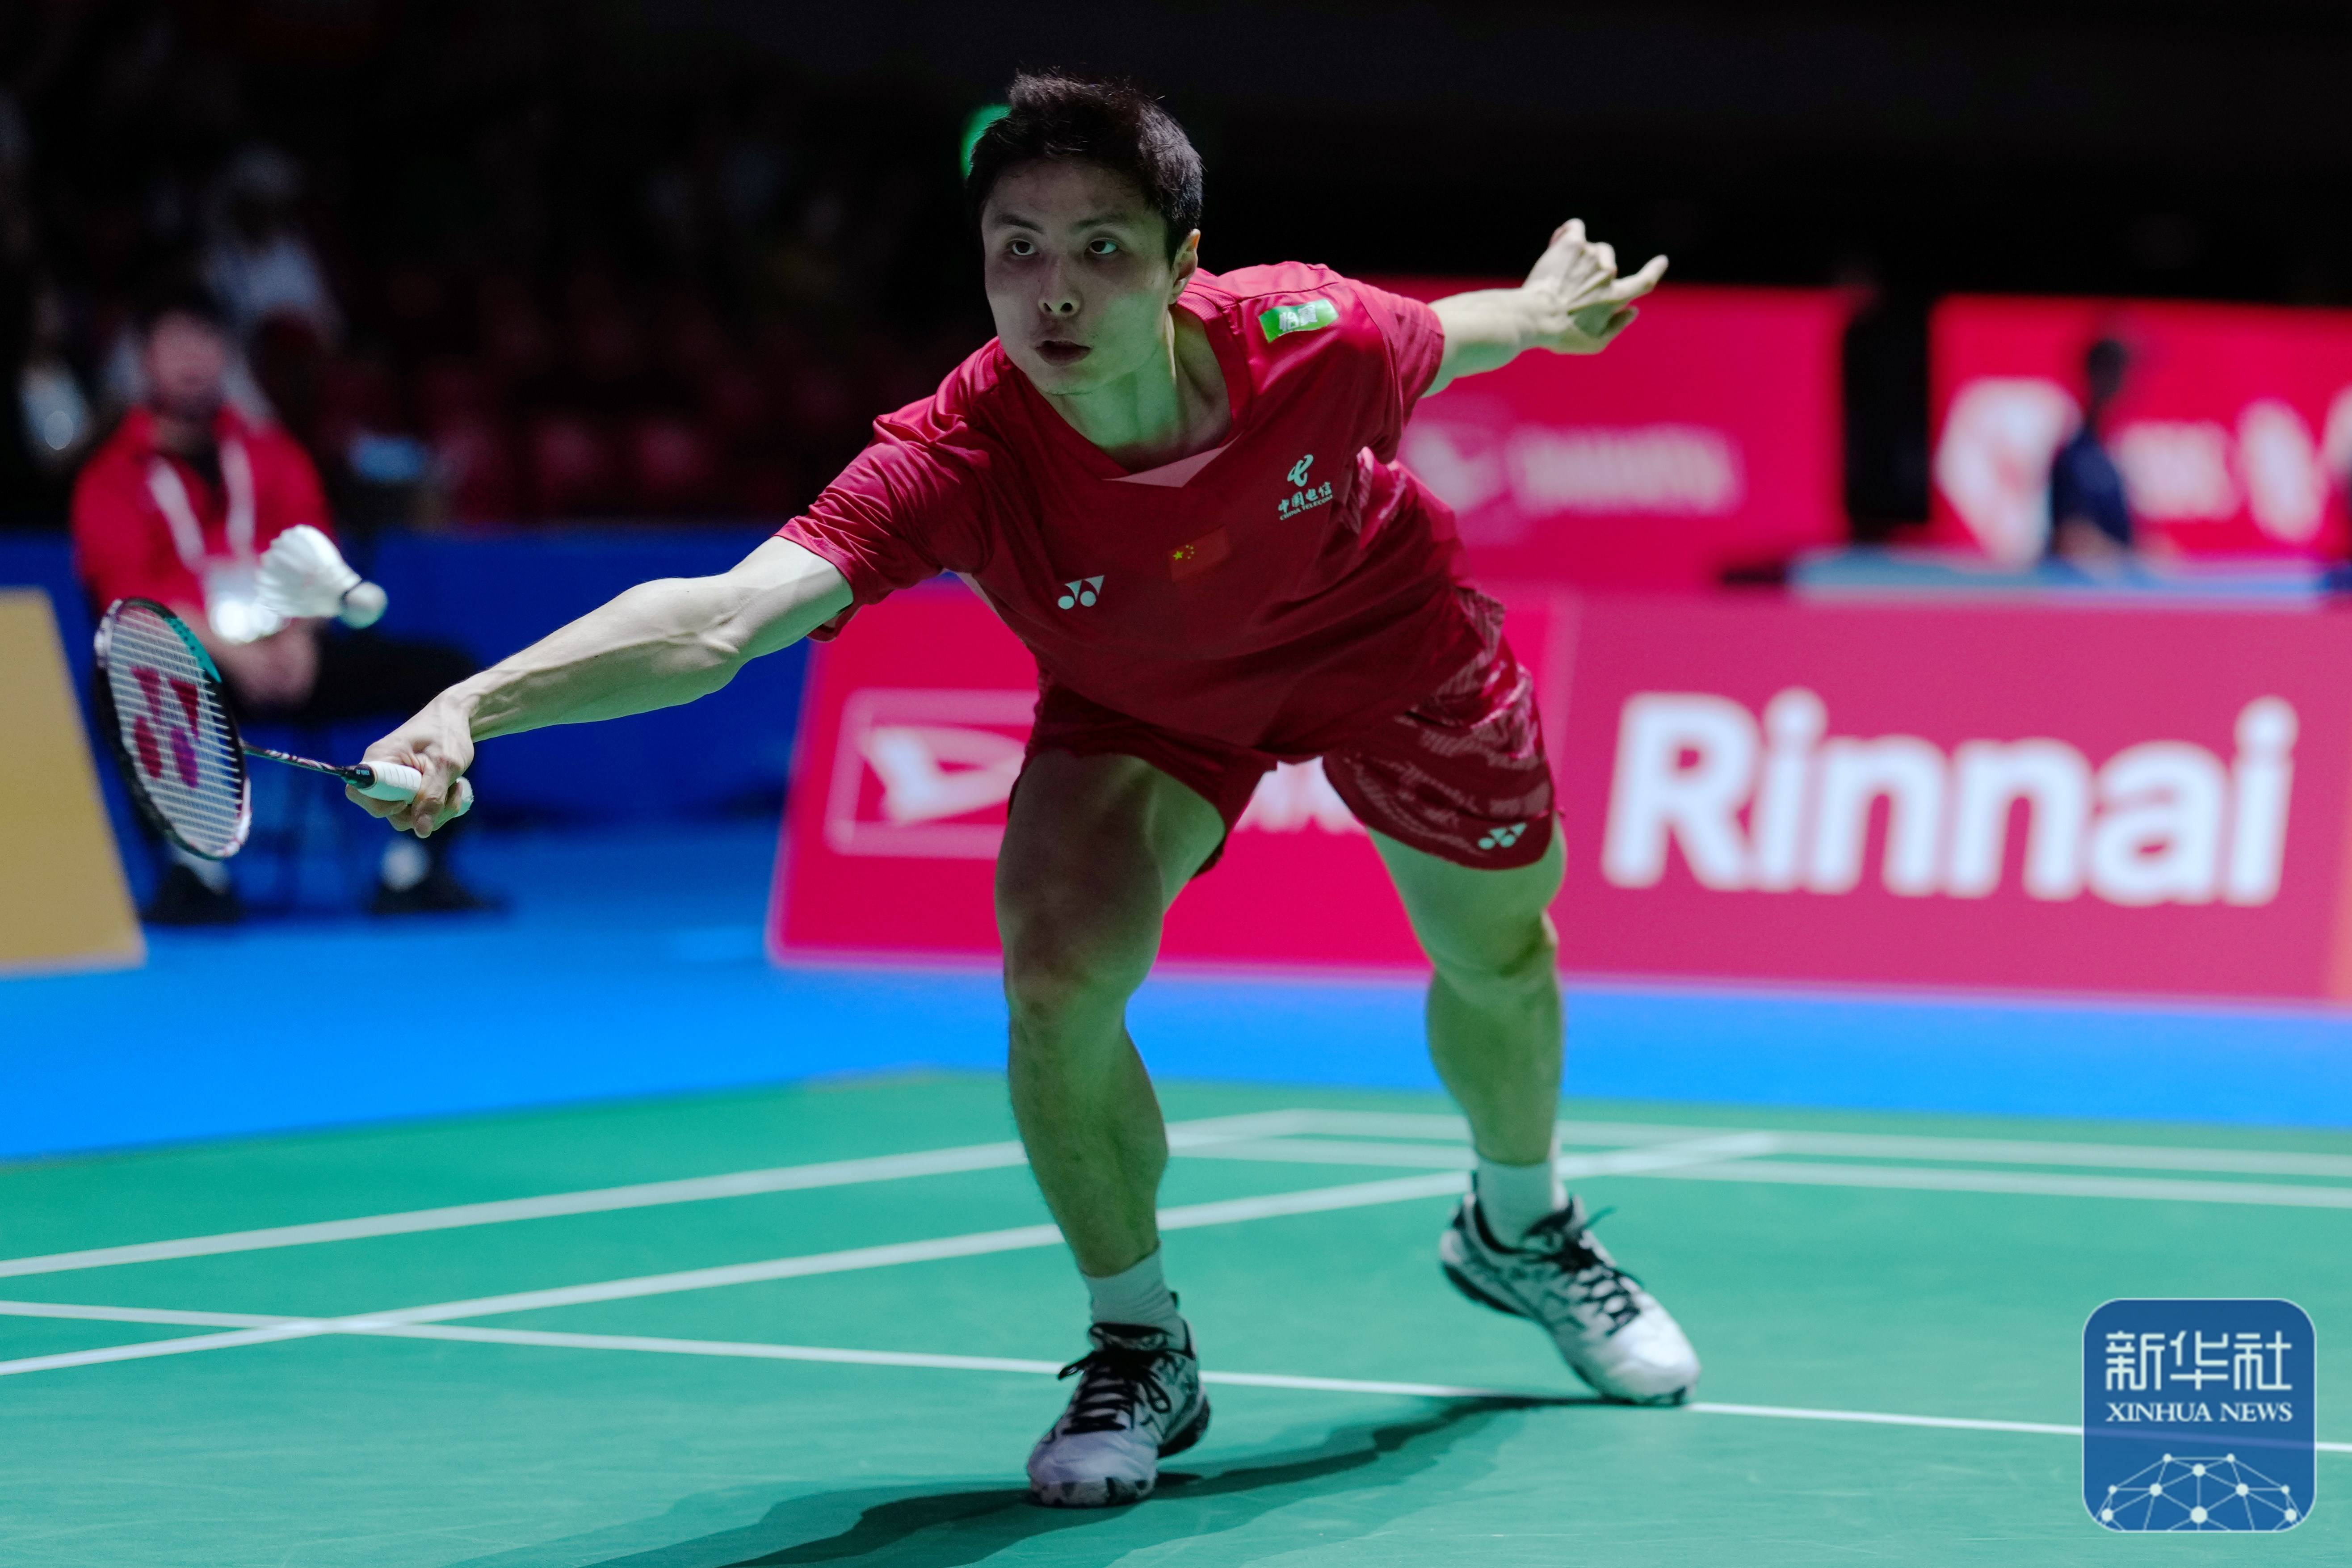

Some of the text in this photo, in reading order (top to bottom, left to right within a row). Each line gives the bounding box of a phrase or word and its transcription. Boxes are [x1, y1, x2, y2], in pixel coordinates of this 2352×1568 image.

[1280, 494, 1333, 521] CHINA TELECOM
[1601, 687, 2300, 907] Rinnai
